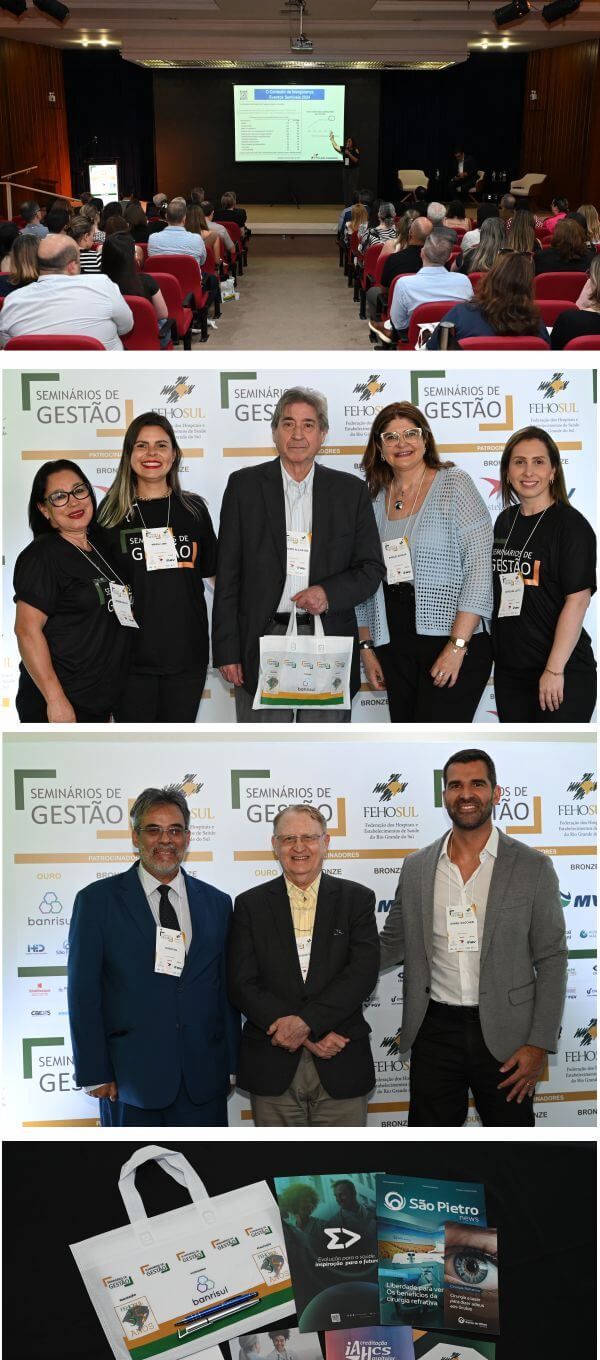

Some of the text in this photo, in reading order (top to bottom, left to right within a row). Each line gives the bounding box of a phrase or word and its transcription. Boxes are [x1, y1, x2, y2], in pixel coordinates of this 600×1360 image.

[36, 387, 119, 400] SEMINÁRIOS DE
[234, 388, 285, 399] SEMINÁRI
[424, 384, 500, 396] SEMINÁRIOS DE
[37, 402, 120, 424] GESTÃO
[234, 404, 273, 421] GES
[424, 398, 501, 419] GESTÃO
[529, 403, 578, 413] FEHOSUL
[522, 551, 532, 559] DE
[31, 786, 121, 799] SEMINÁRIOS DE
[247, 785, 331, 798] SEMINÁRIOS DE
[515, 786, 527, 796] DE
[31, 800, 123, 824] GESTÃO
[364, 806, 419, 818] FEHOSUL
[28, 917, 70, 926] banrisu
[39, 1056, 74, 1067] SEMIN
[565, 1051, 596, 1062] FEHO
[409, 1199, 479, 1215] São Pietro
[217, 1239, 237, 1250] GESTÃO
[146, 1265, 167, 1276] GESTÃO
[109, 1278, 130, 1289] GESTÃO
[387, 1283, 418, 1291] Liberdade
[192, 1286, 228, 1306] banrisul
